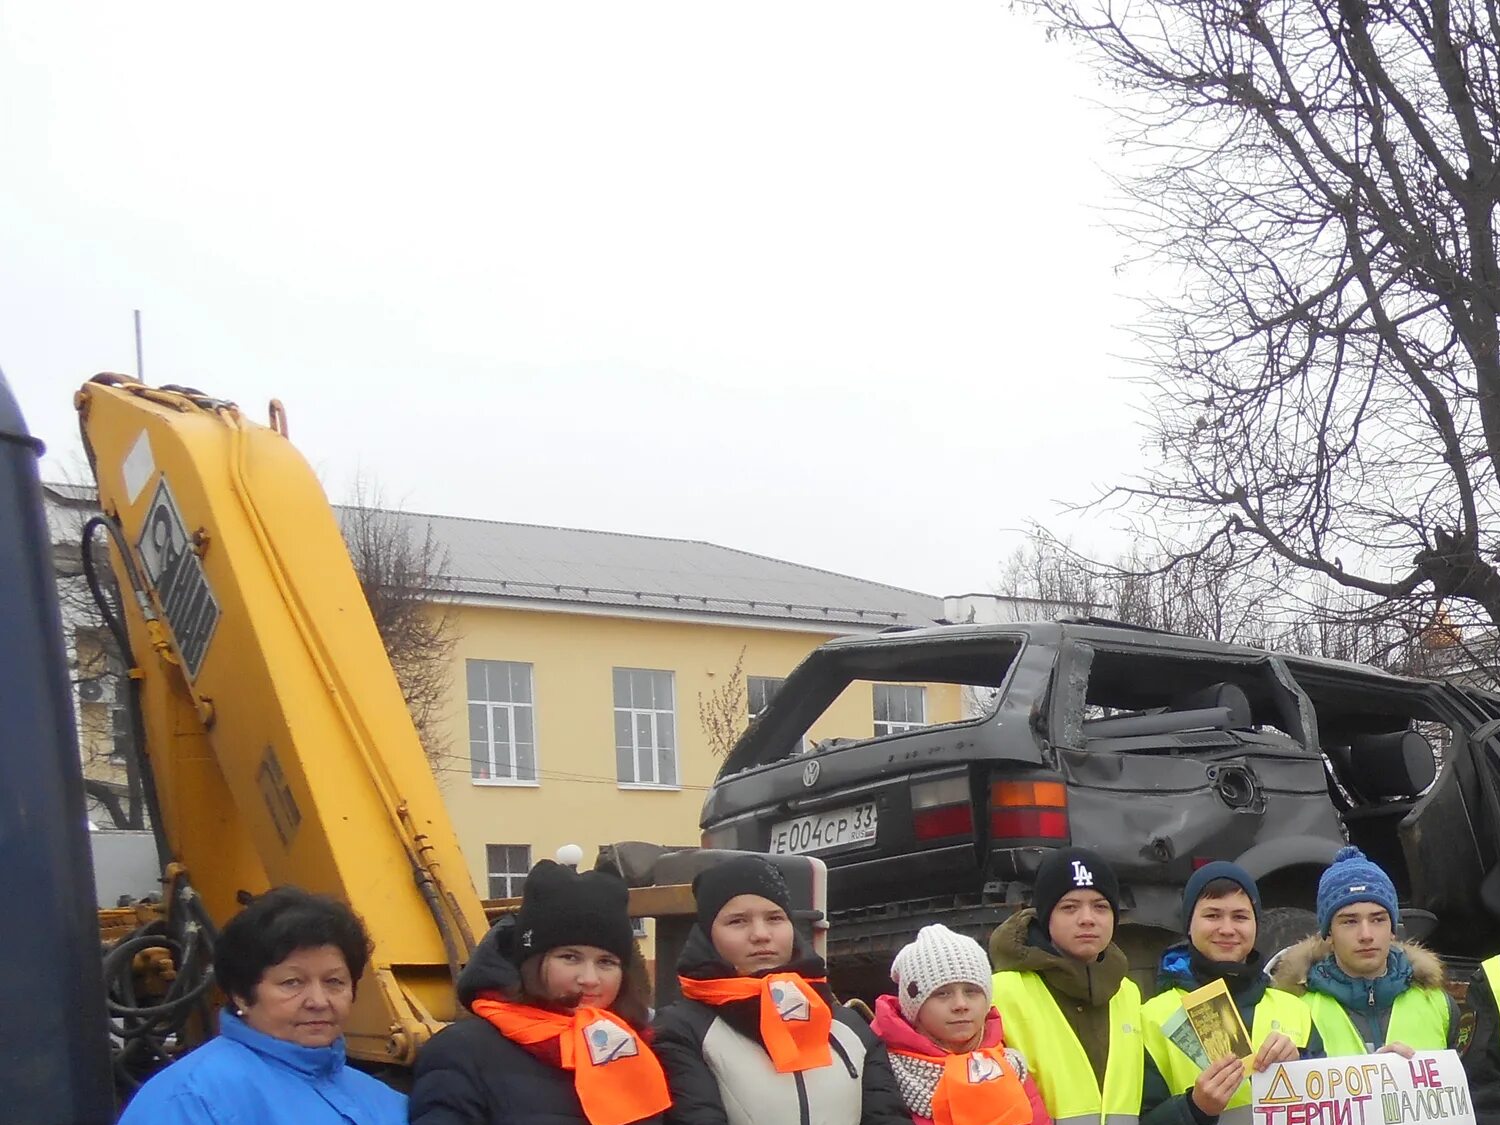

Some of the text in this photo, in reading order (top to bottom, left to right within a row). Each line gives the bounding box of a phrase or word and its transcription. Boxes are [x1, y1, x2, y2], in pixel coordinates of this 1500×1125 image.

[853, 804, 873, 830] 33
[1071, 860, 1094, 887] LA
[1259, 1058, 1442, 1104] ДОРОГА НЕ
[1381, 1086, 1470, 1125] ШАЛОСТИ
